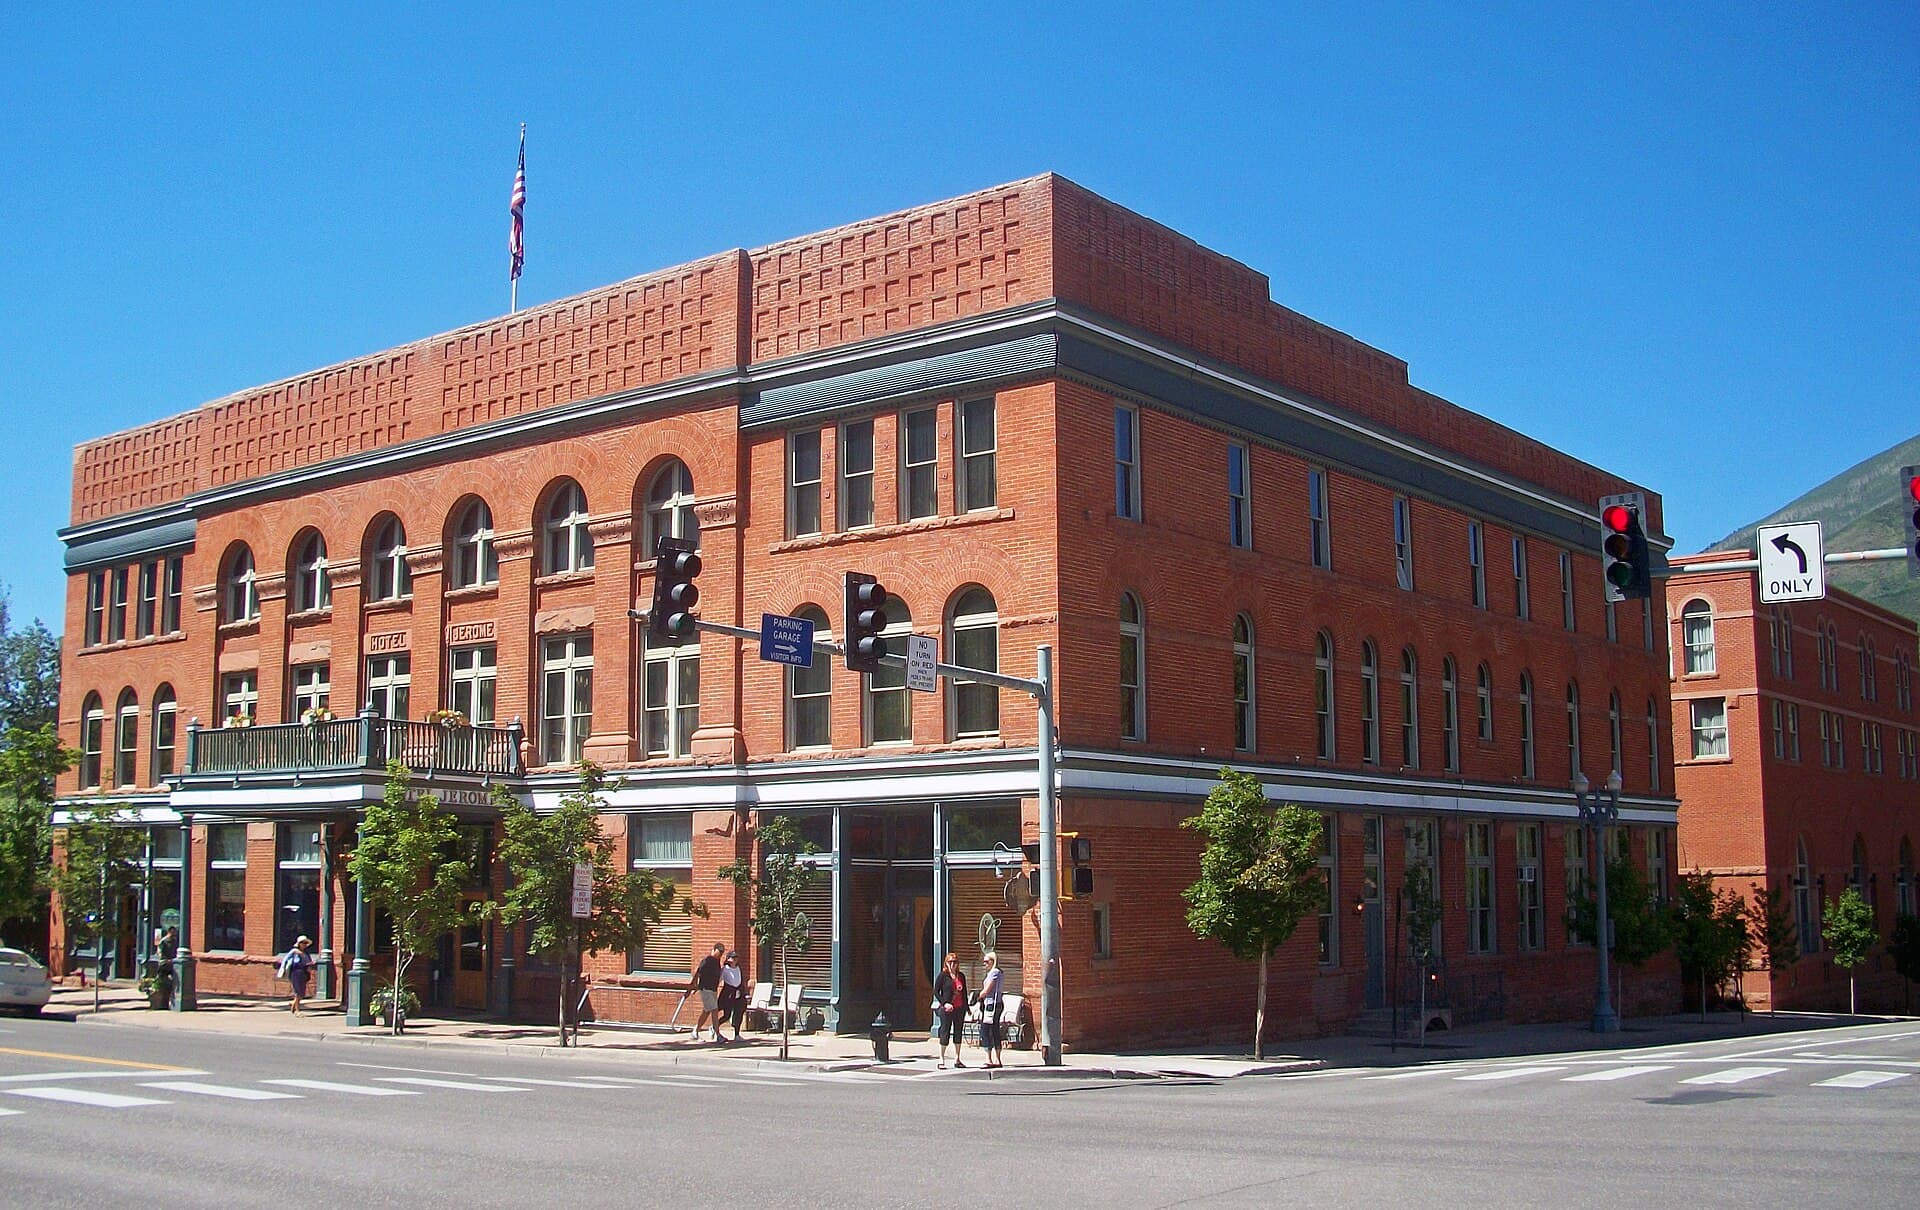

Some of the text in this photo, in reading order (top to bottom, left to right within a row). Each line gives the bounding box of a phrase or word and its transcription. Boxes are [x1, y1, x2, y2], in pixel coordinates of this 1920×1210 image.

[1770, 578, 1813, 595] ONLY
[773, 618, 803, 631] PARKING
[371, 622, 495, 651] HOTEL JEROME
[773, 630, 801, 643] GARAGE
[919, 641, 927, 649] NO
[770, 652, 790, 661] VISITOR
[916, 651, 931, 660] TURN
